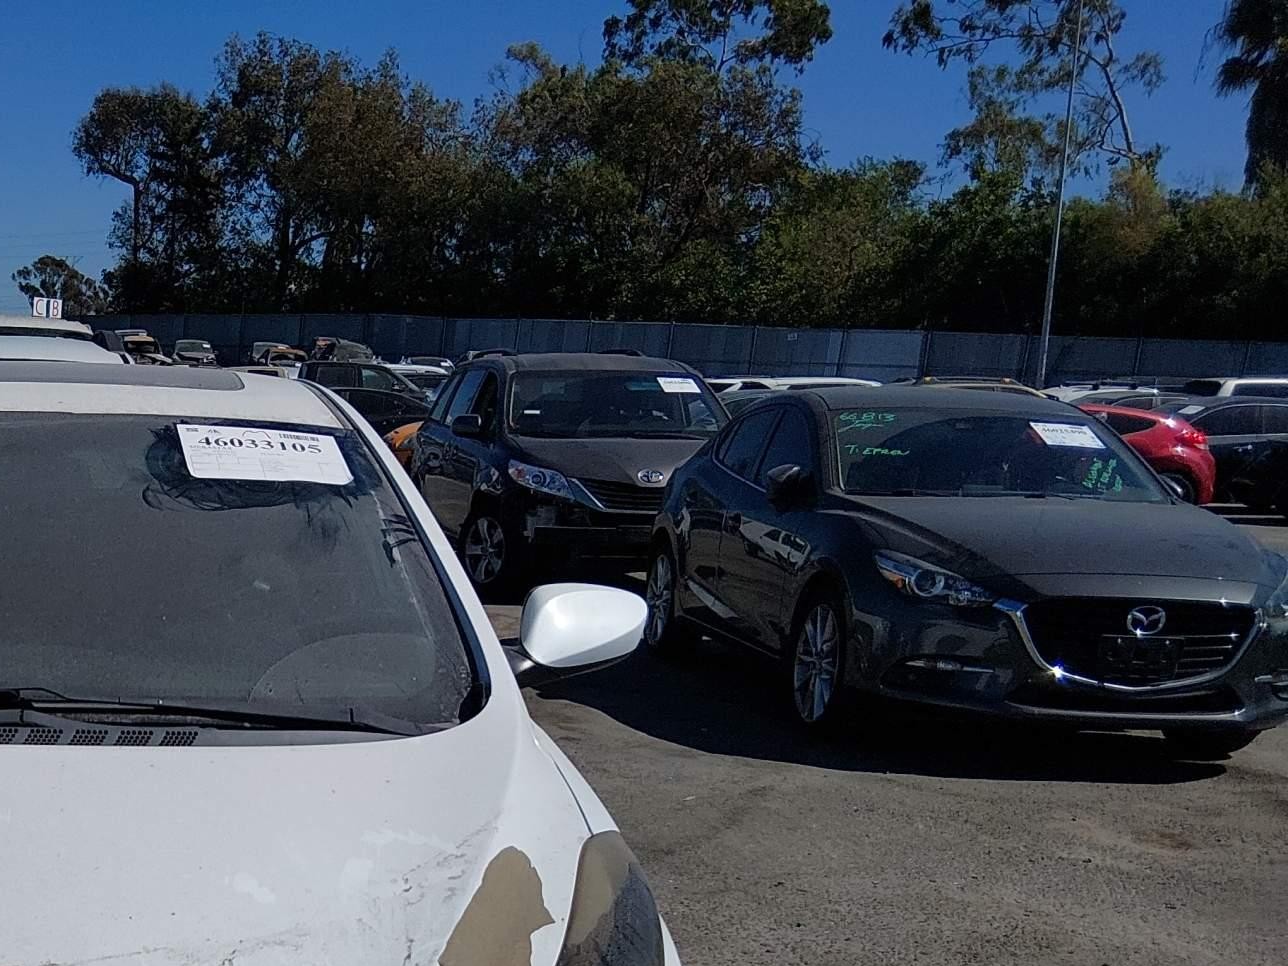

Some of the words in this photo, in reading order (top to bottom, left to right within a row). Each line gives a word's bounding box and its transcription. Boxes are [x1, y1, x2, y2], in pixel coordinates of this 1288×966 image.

[35, 298, 45, 315] C
[52, 299, 59, 317] B
[197, 436, 323, 454] 46033105
